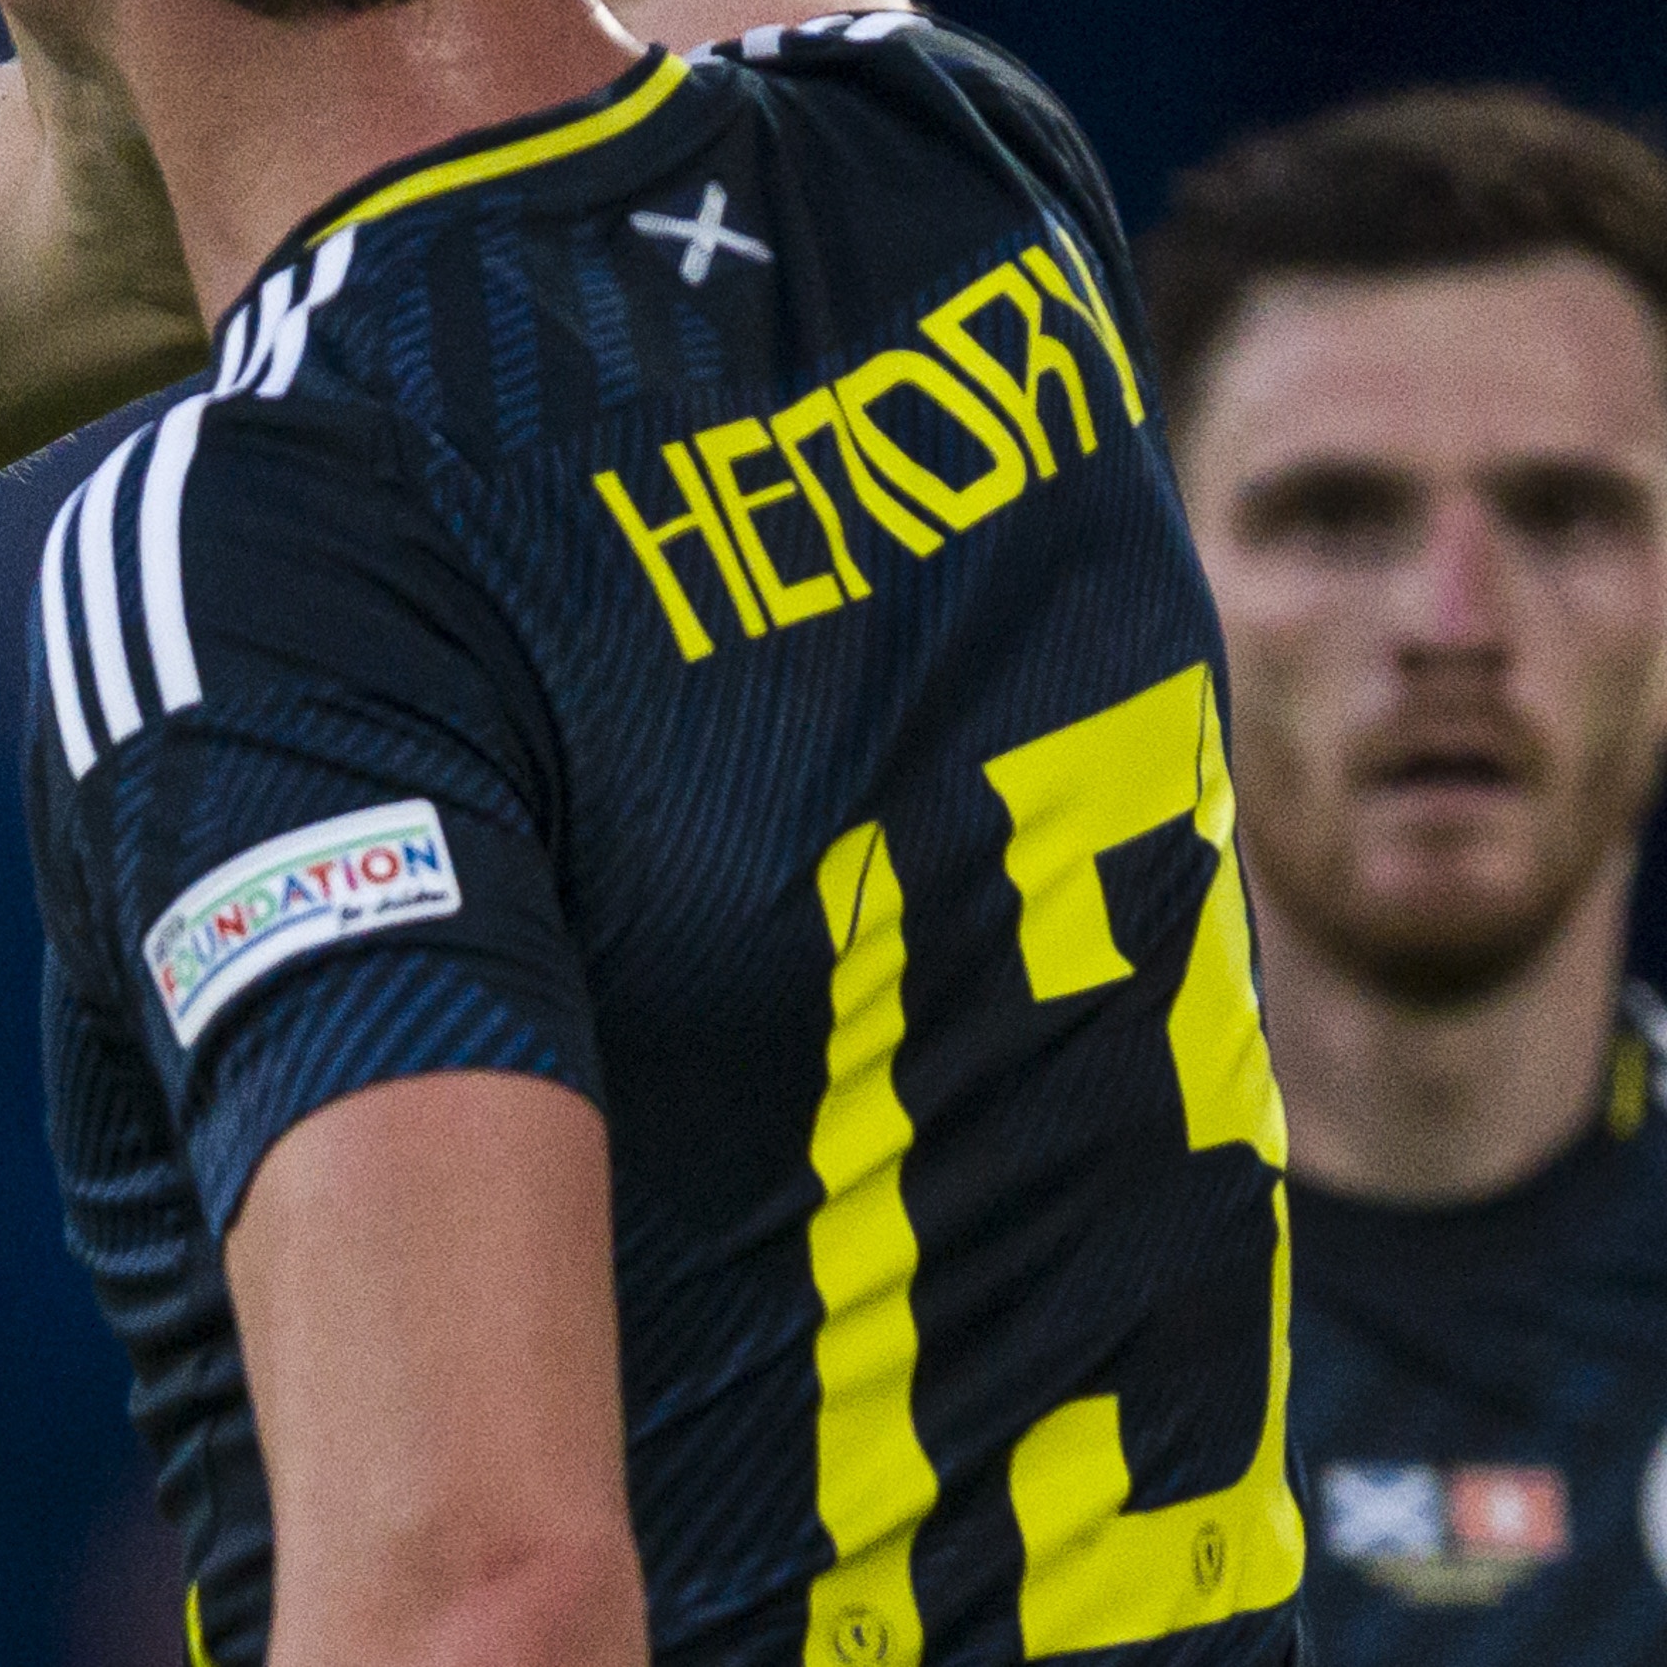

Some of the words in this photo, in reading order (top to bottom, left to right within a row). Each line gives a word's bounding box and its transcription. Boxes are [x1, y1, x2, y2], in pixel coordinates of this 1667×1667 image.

[592, 226, 1146, 664] HENDRY
[161, 838, 441, 1002] FOUNDATION
[803, 661, 1305, 1667] 13
